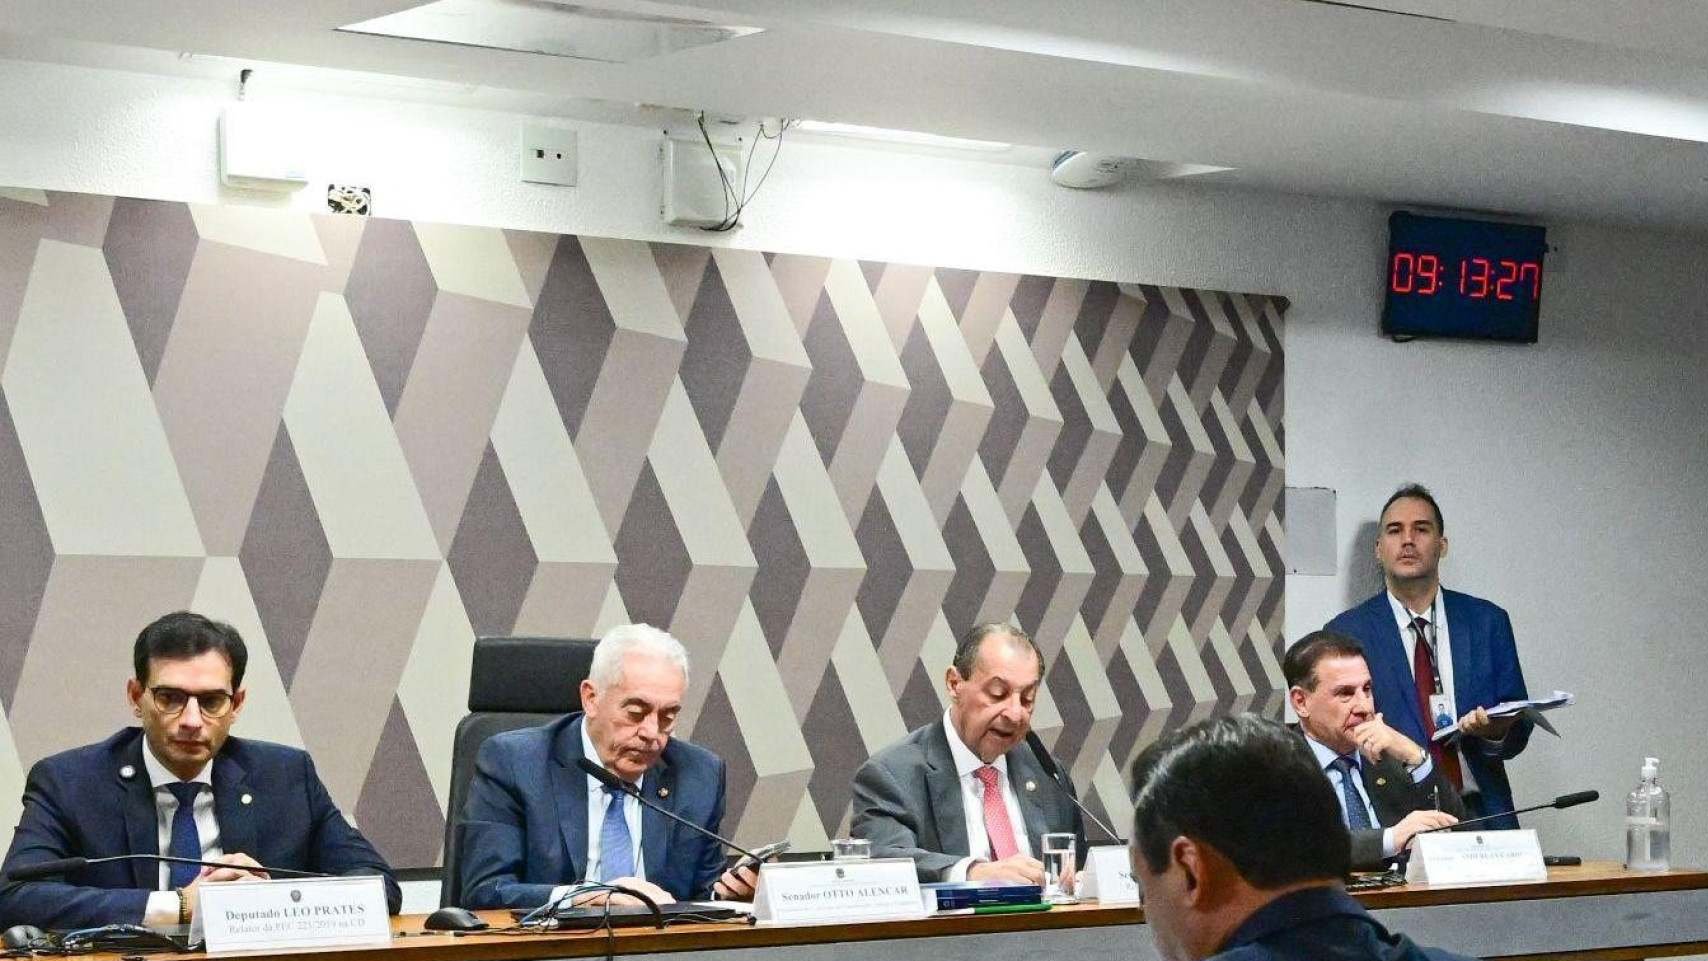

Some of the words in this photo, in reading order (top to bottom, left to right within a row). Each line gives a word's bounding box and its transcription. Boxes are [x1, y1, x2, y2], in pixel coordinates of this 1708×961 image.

[1392, 253, 1540, 299] 09:13:27
[823, 888, 854, 900] OTTO
[857, 886, 908, 898] ALENCAR
[225, 908, 281, 922] Deputado
[314, 903, 366, 916] PRATES
